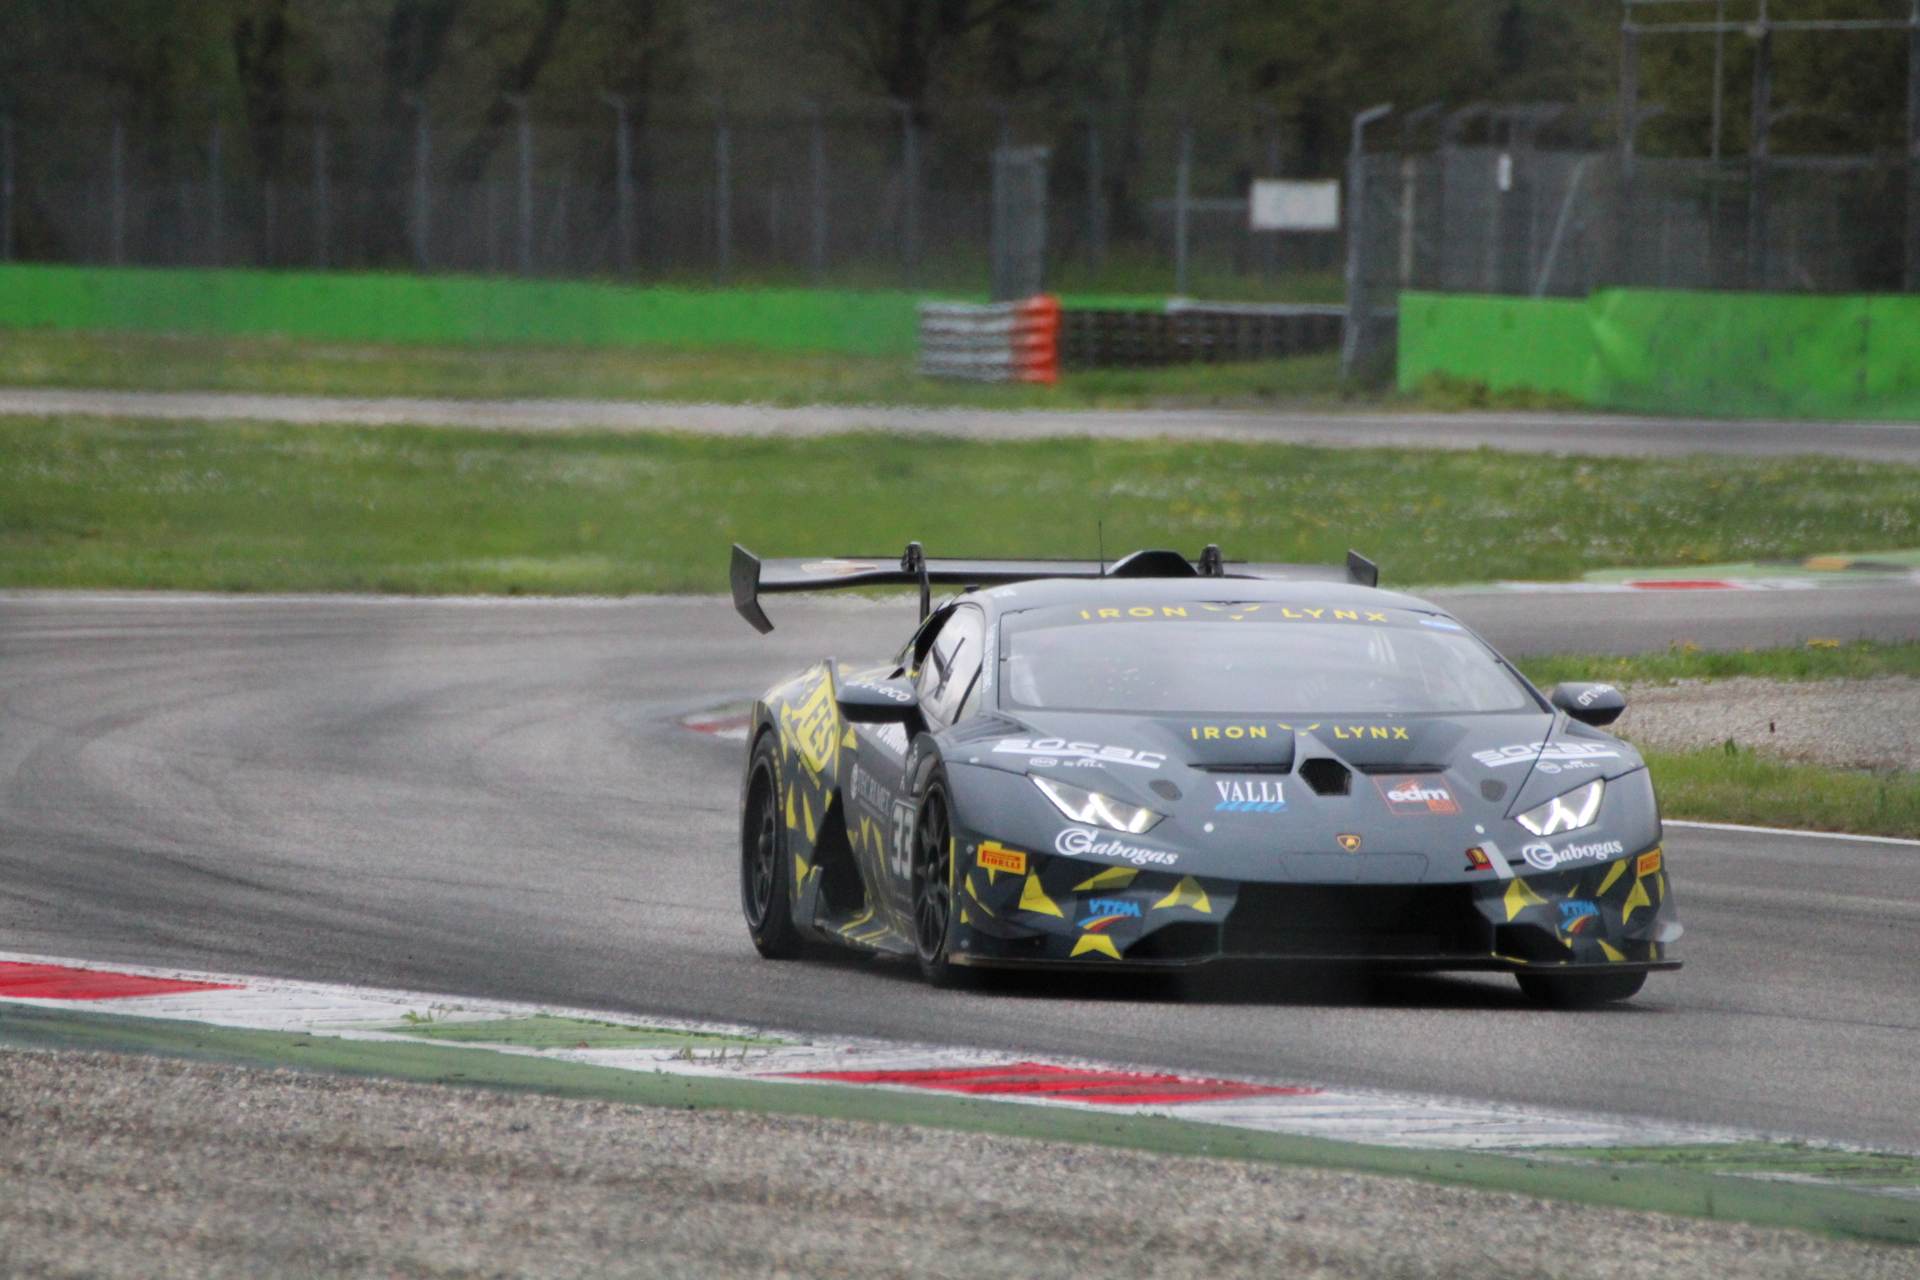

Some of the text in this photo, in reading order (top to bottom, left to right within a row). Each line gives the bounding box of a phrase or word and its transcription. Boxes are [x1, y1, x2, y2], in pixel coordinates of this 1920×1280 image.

[1080, 606, 1388, 623] IRON LYNX
[1191, 726, 1409, 740] IRON LYNX
[1216, 781, 1284, 802] VALLI
[1387, 785, 1450, 801] edm
[891, 804, 915, 880] 33
[1055, 828, 1178, 865] Gabogas
[981, 850, 1021, 870] PIRELLI
[1522, 840, 1623, 869] Gabogas
